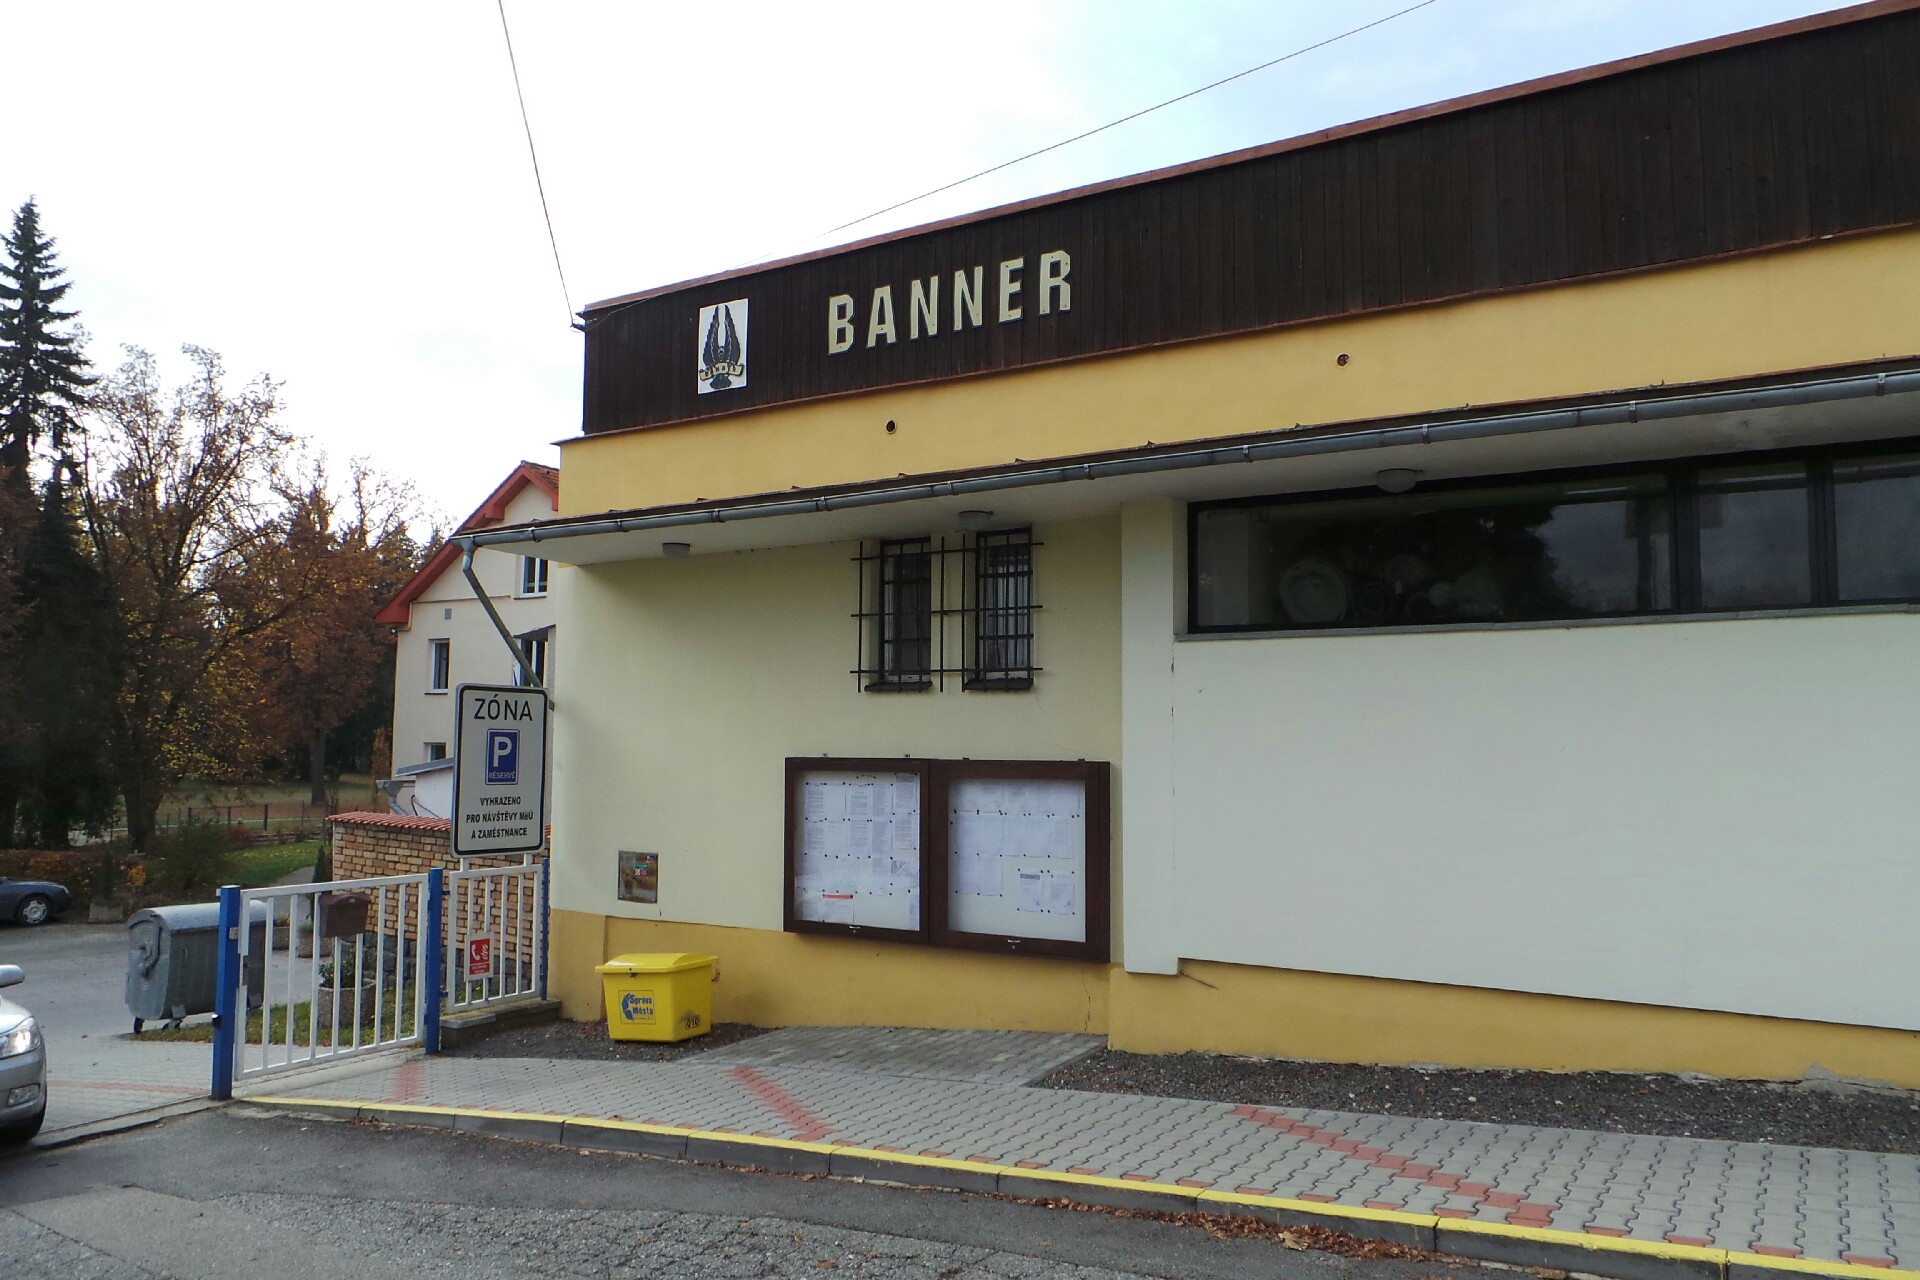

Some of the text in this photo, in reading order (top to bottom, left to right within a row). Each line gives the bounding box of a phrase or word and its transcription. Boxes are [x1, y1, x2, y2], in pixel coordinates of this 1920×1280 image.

[827, 249, 1072, 356] BANNER
[474, 693, 533, 722] ZÓNA
[493, 736, 512, 768] P
[480, 796, 521, 807] VYHRAZENO
[466, 813, 481, 824] PRO
[482, 810, 518, 823] NÁVŠTĚVY
[471, 830, 476, 839] A
